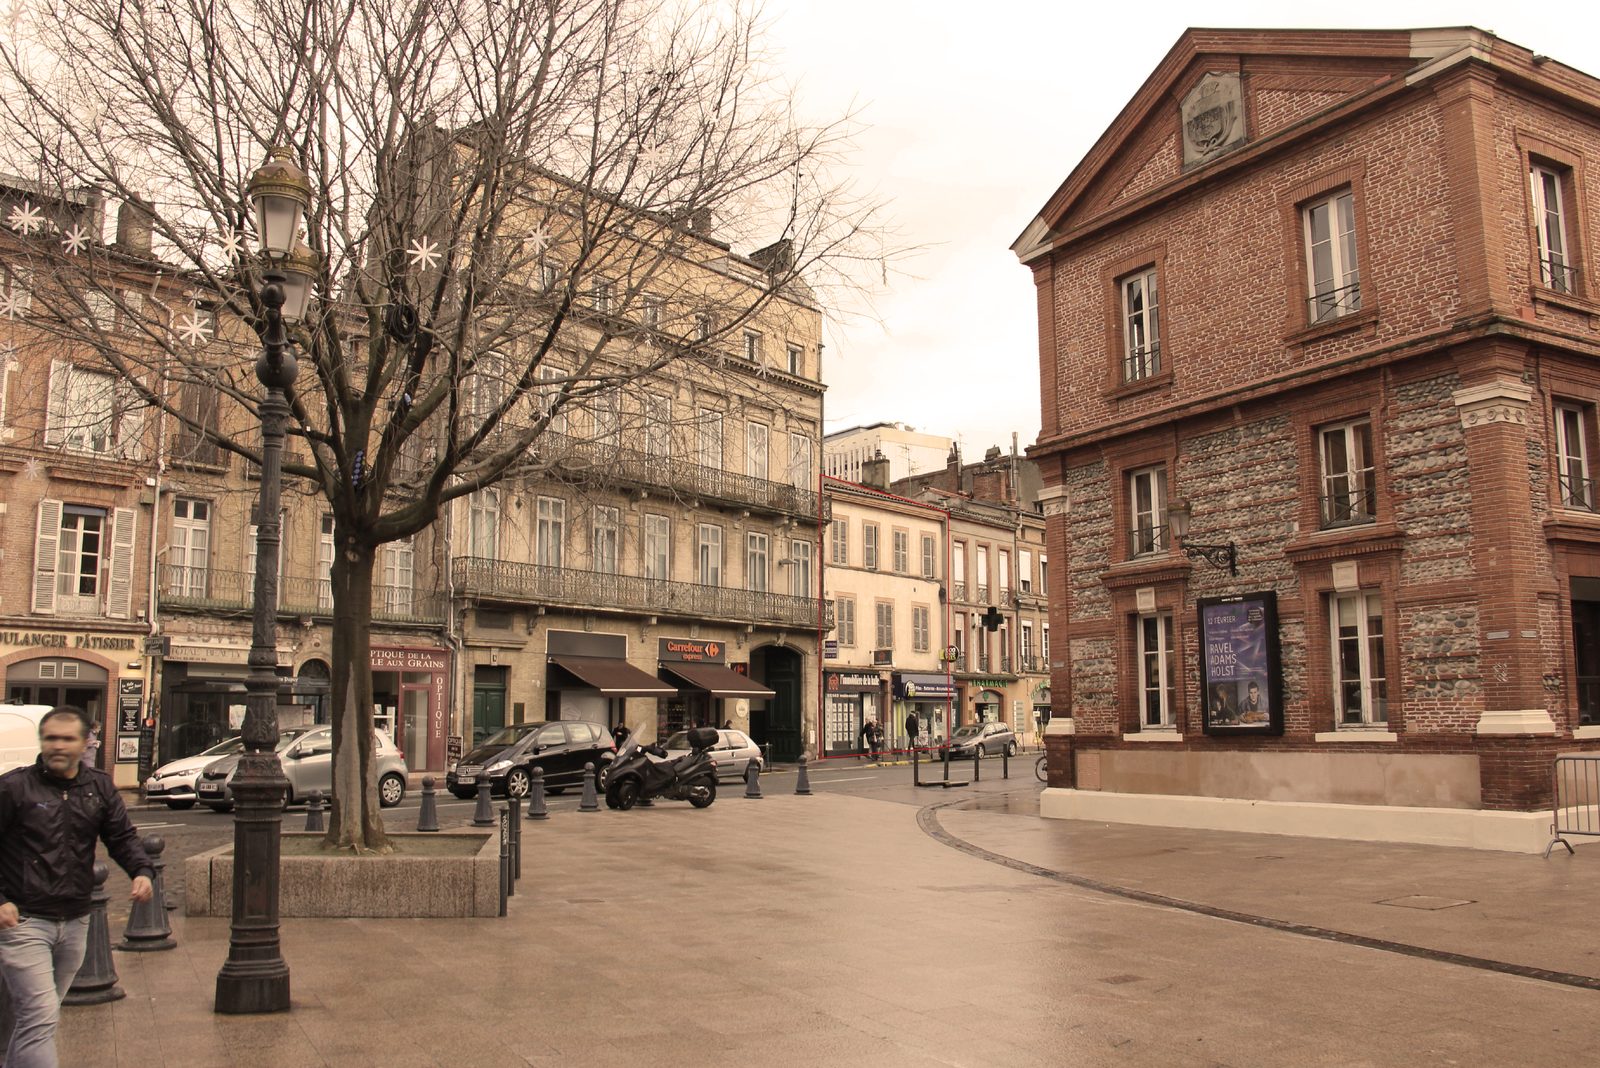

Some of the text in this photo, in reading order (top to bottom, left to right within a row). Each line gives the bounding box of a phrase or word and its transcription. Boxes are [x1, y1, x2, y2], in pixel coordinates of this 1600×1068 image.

[1214, 615, 1236, 625] FÉVRIER
[75, 634, 135, 650] PÂTISSIER
[667, 641, 704, 653] Carrefour
[1210, 643, 1234, 654] RAVEL
[370, 650, 405, 659] PTIQUE
[682, 653, 703, 661] express
[1211, 653, 1237, 665] ADAMS
[371, 658, 384, 666] LE
[407, 659, 444, 669] GRAINS
[1211, 665, 1235, 677] HOLST
[435, 676, 443, 738] OPTIQUE
